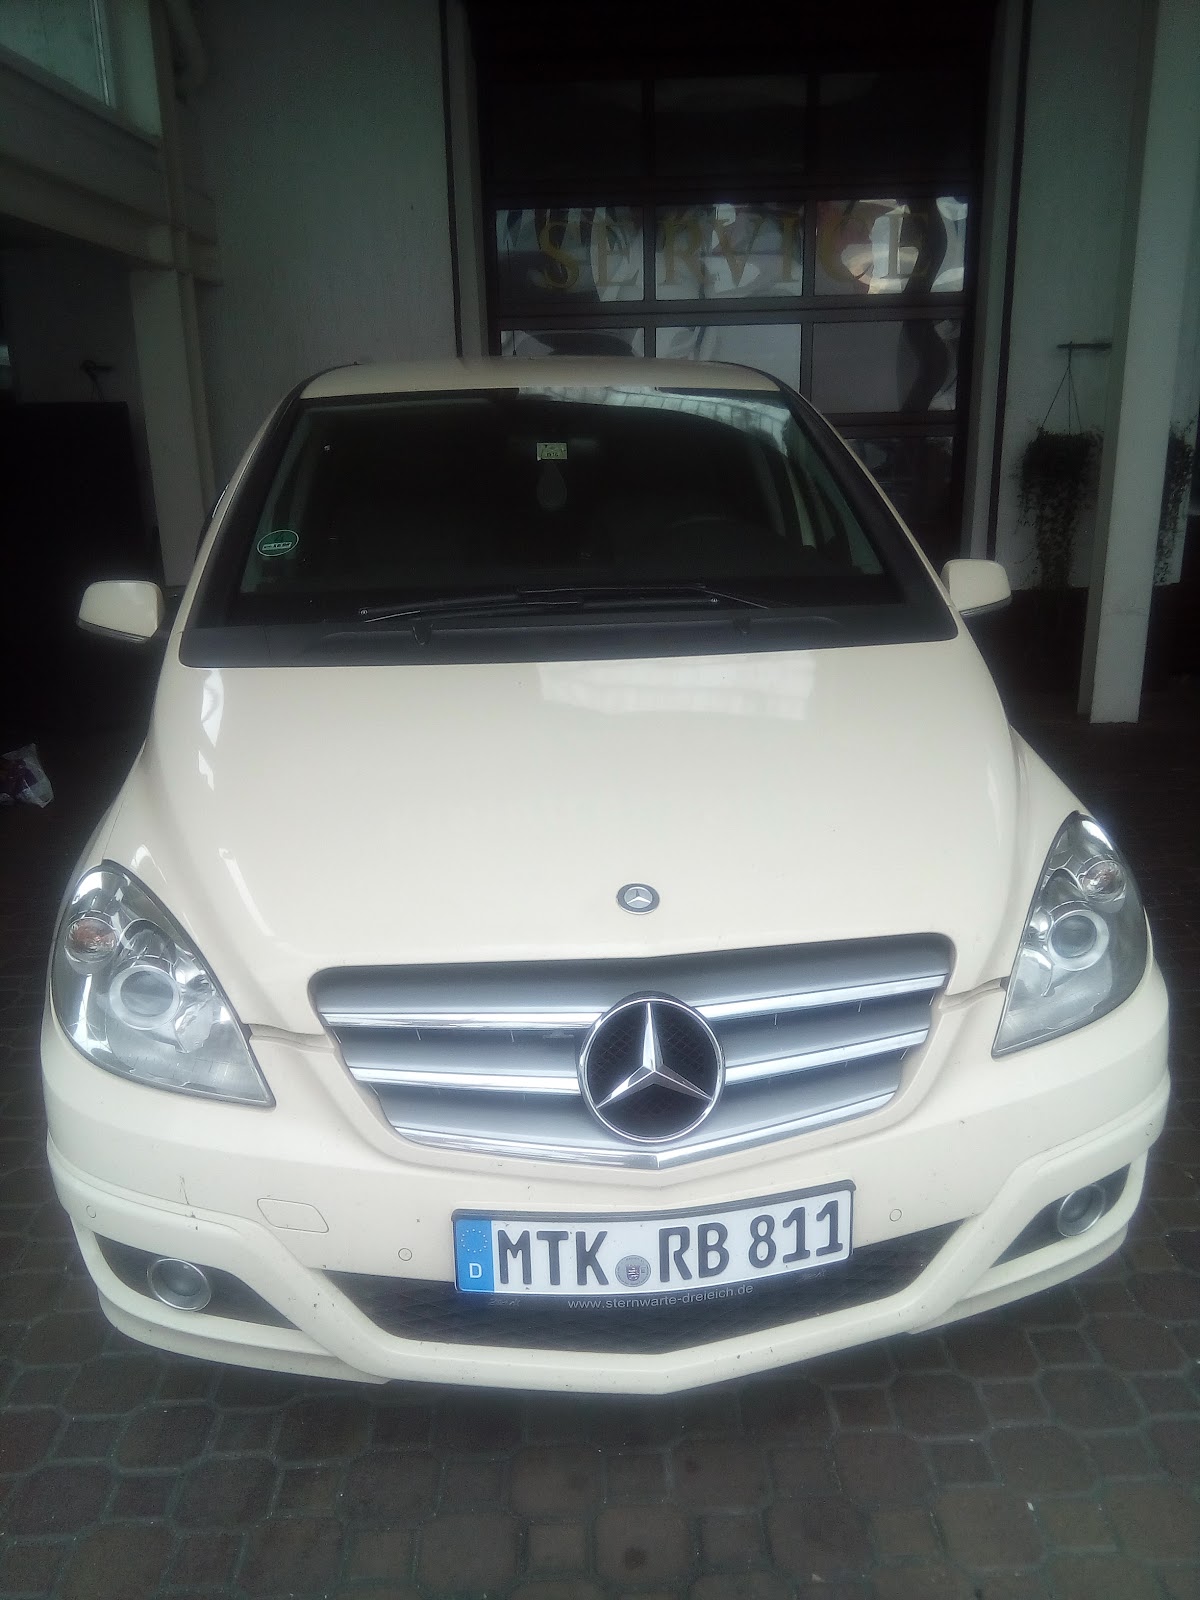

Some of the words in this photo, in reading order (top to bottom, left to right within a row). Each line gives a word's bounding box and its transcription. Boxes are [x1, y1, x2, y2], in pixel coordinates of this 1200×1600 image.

[538, 211, 928, 291] SERVICE
[497, 1229, 610, 1286] MTK
[658, 1222, 730, 1283] RB
[748, 1199, 844, 1269] 811
[469, 1262, 483, 1279] D
[567, 1284, 754, 1309] www.sternwarte-dreieich.de
